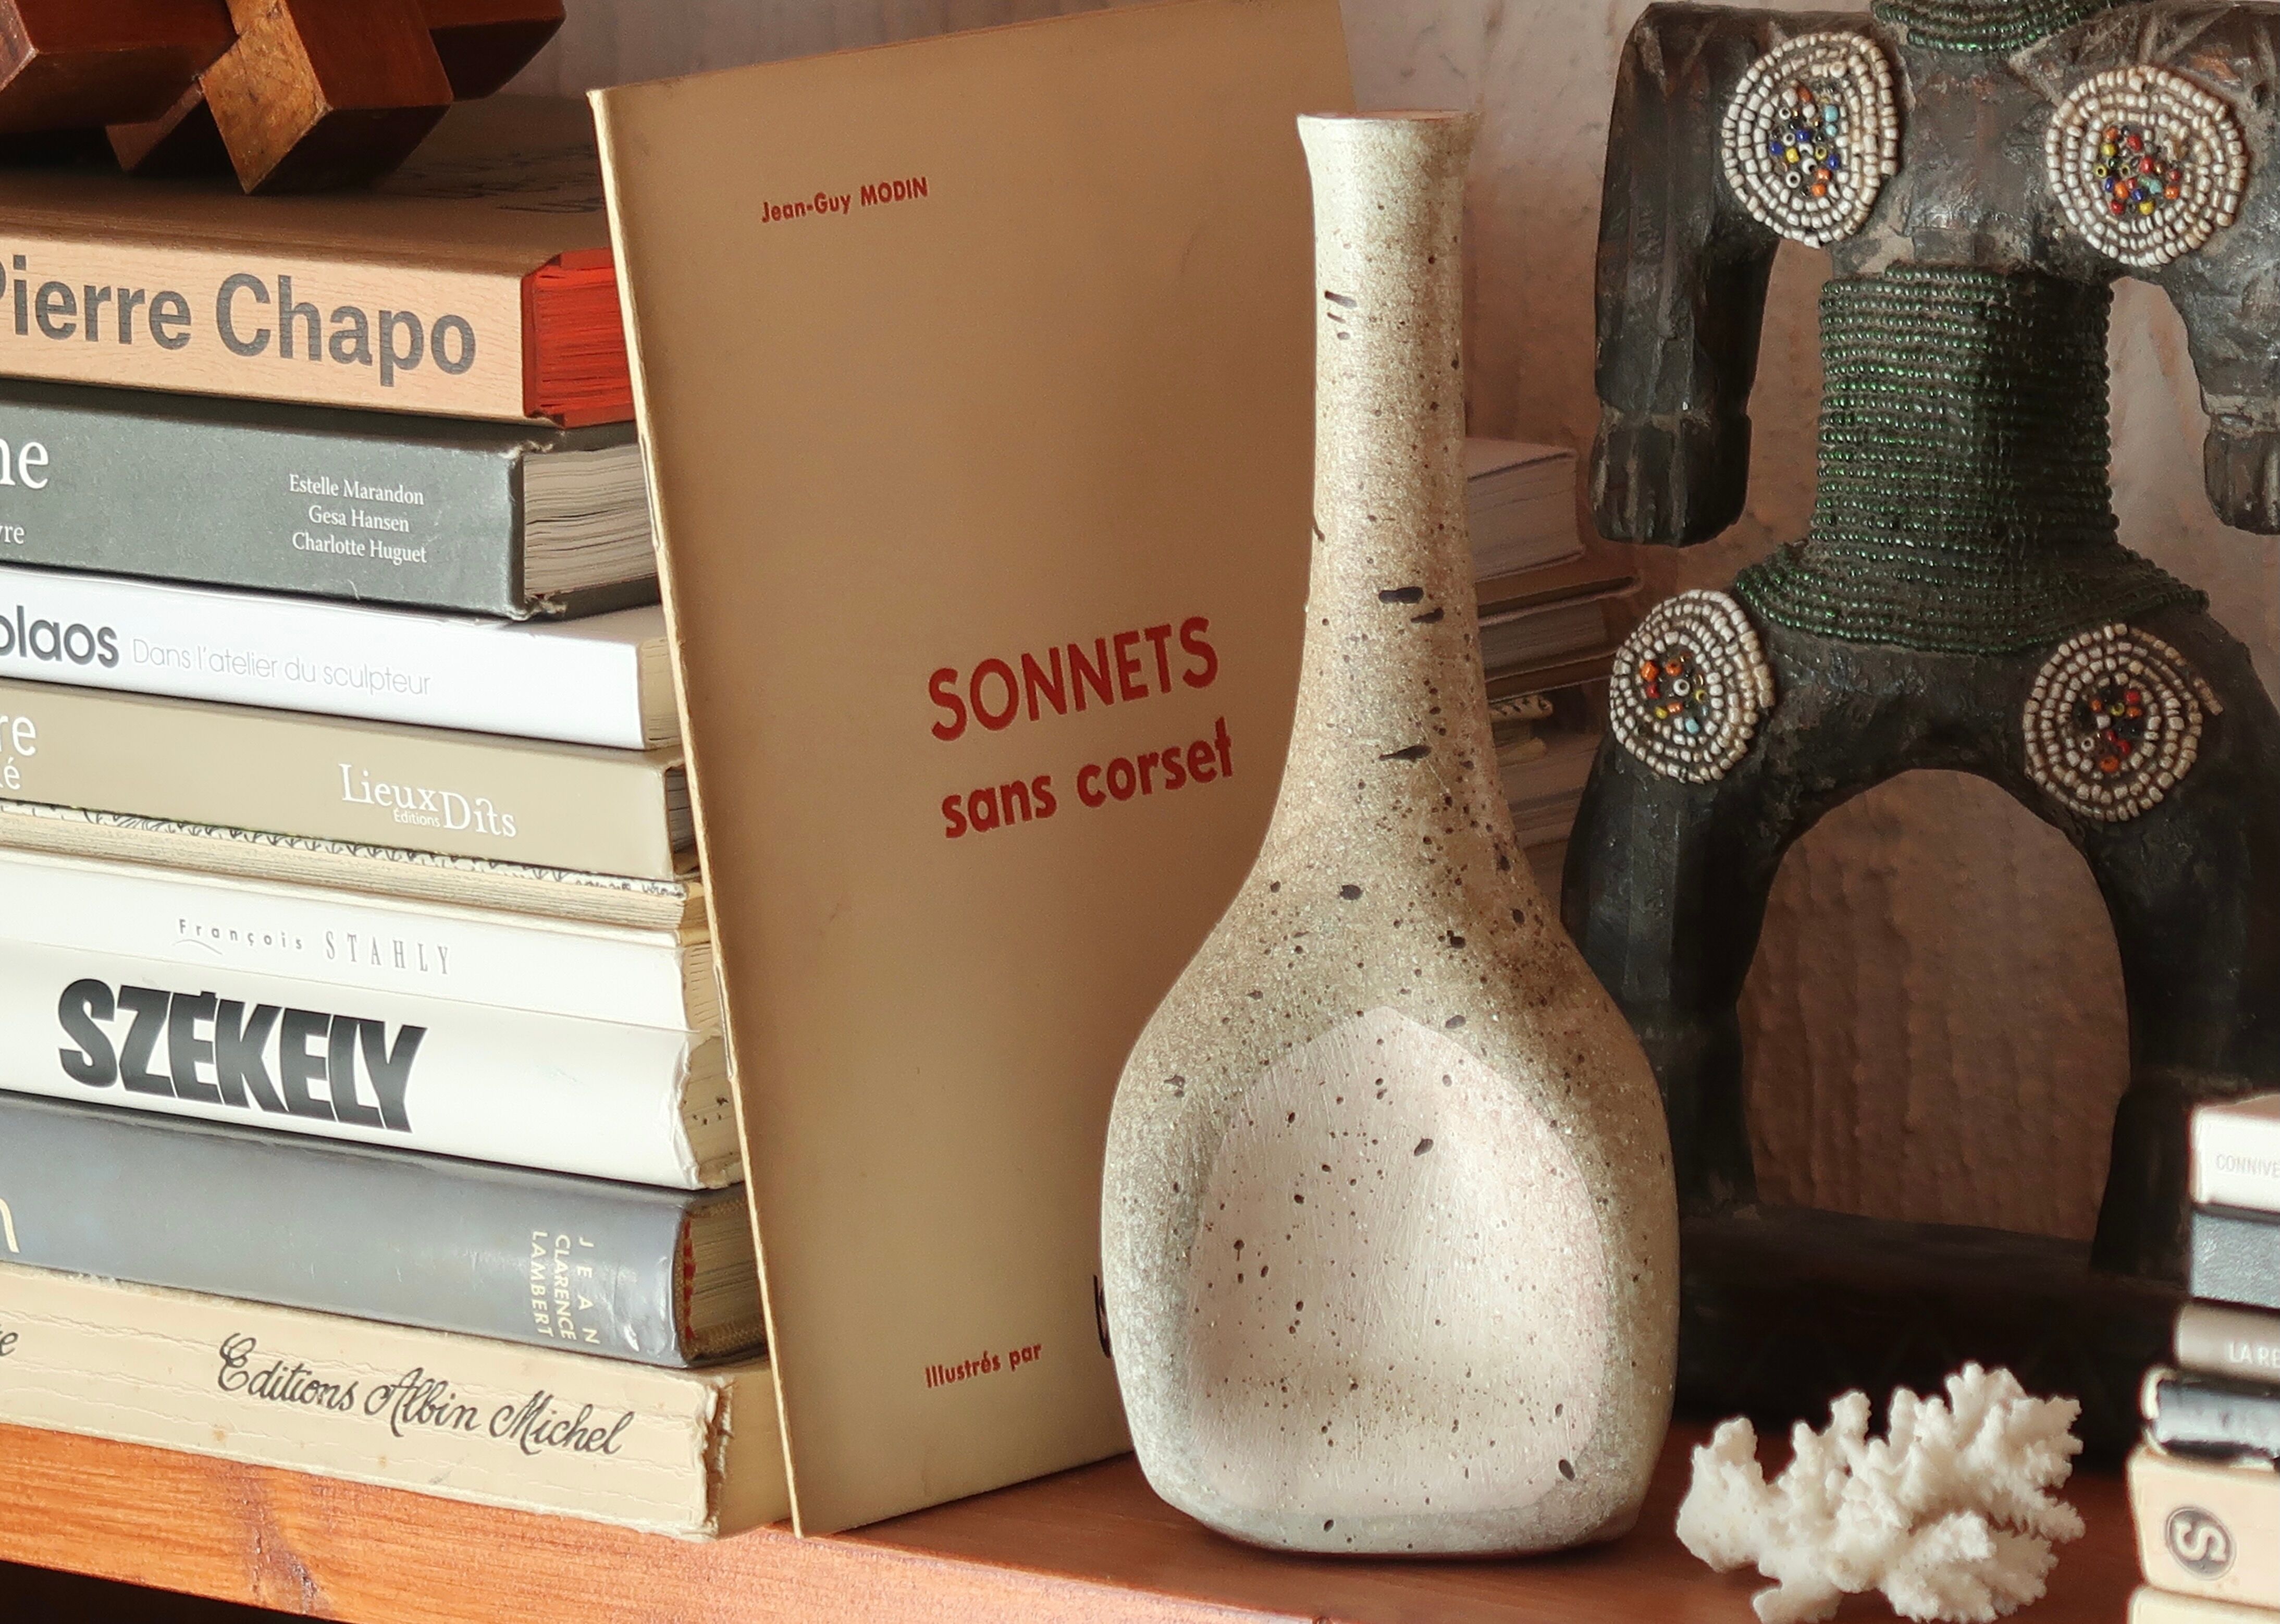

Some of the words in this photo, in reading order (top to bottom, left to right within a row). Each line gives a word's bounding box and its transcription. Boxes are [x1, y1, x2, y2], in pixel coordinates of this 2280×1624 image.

[761, 192, 851, 223] Jean-Guy
[861, 176, 928, 206] MODIN
[0, 254, 192, 350] ierre
[216, 273, 476, 387] Chapo
[289, 473, 339, 496] Estelle
[343, 478, 425, 505] Marandon
[0, 525, 25, 544] re
[309, 505, 347, 526] Gesa
[351, 508, 410, 533] Hansen
[292, 532, 365, 557] Charlotte
[369, 539, 427, 565] Huguet
[133, 638, 191, 669] Dans
[197, 645, 278, 678] l'atelier
[284, 657, 316, 683] du
[323, 663, 431, 695] sculpteur
[929, 616, 1219, 742] SONNETS
[941, 774, 1057, 839] sans
[1076, 716, 1233, 808] corset
[393, 807, 441, 828] Éditions
[180, 919, 303, 950] François
[326, 931, 449, 975] STAHLY
[57, 978, 428, 1134] SZÉKELY
[529, 1231, 555, 1338] LAMBERT
[553, 1234, 577, 1340] CLARENCE
[925, 1350, 1001, 1388] Illustrés
[1009, 1343, 1042, 1371] par
[217, 1333, 359, 1410] Editions
[364, 1367, 482, 1438] Albin
[488, 1389, 635, 1456] Michel
